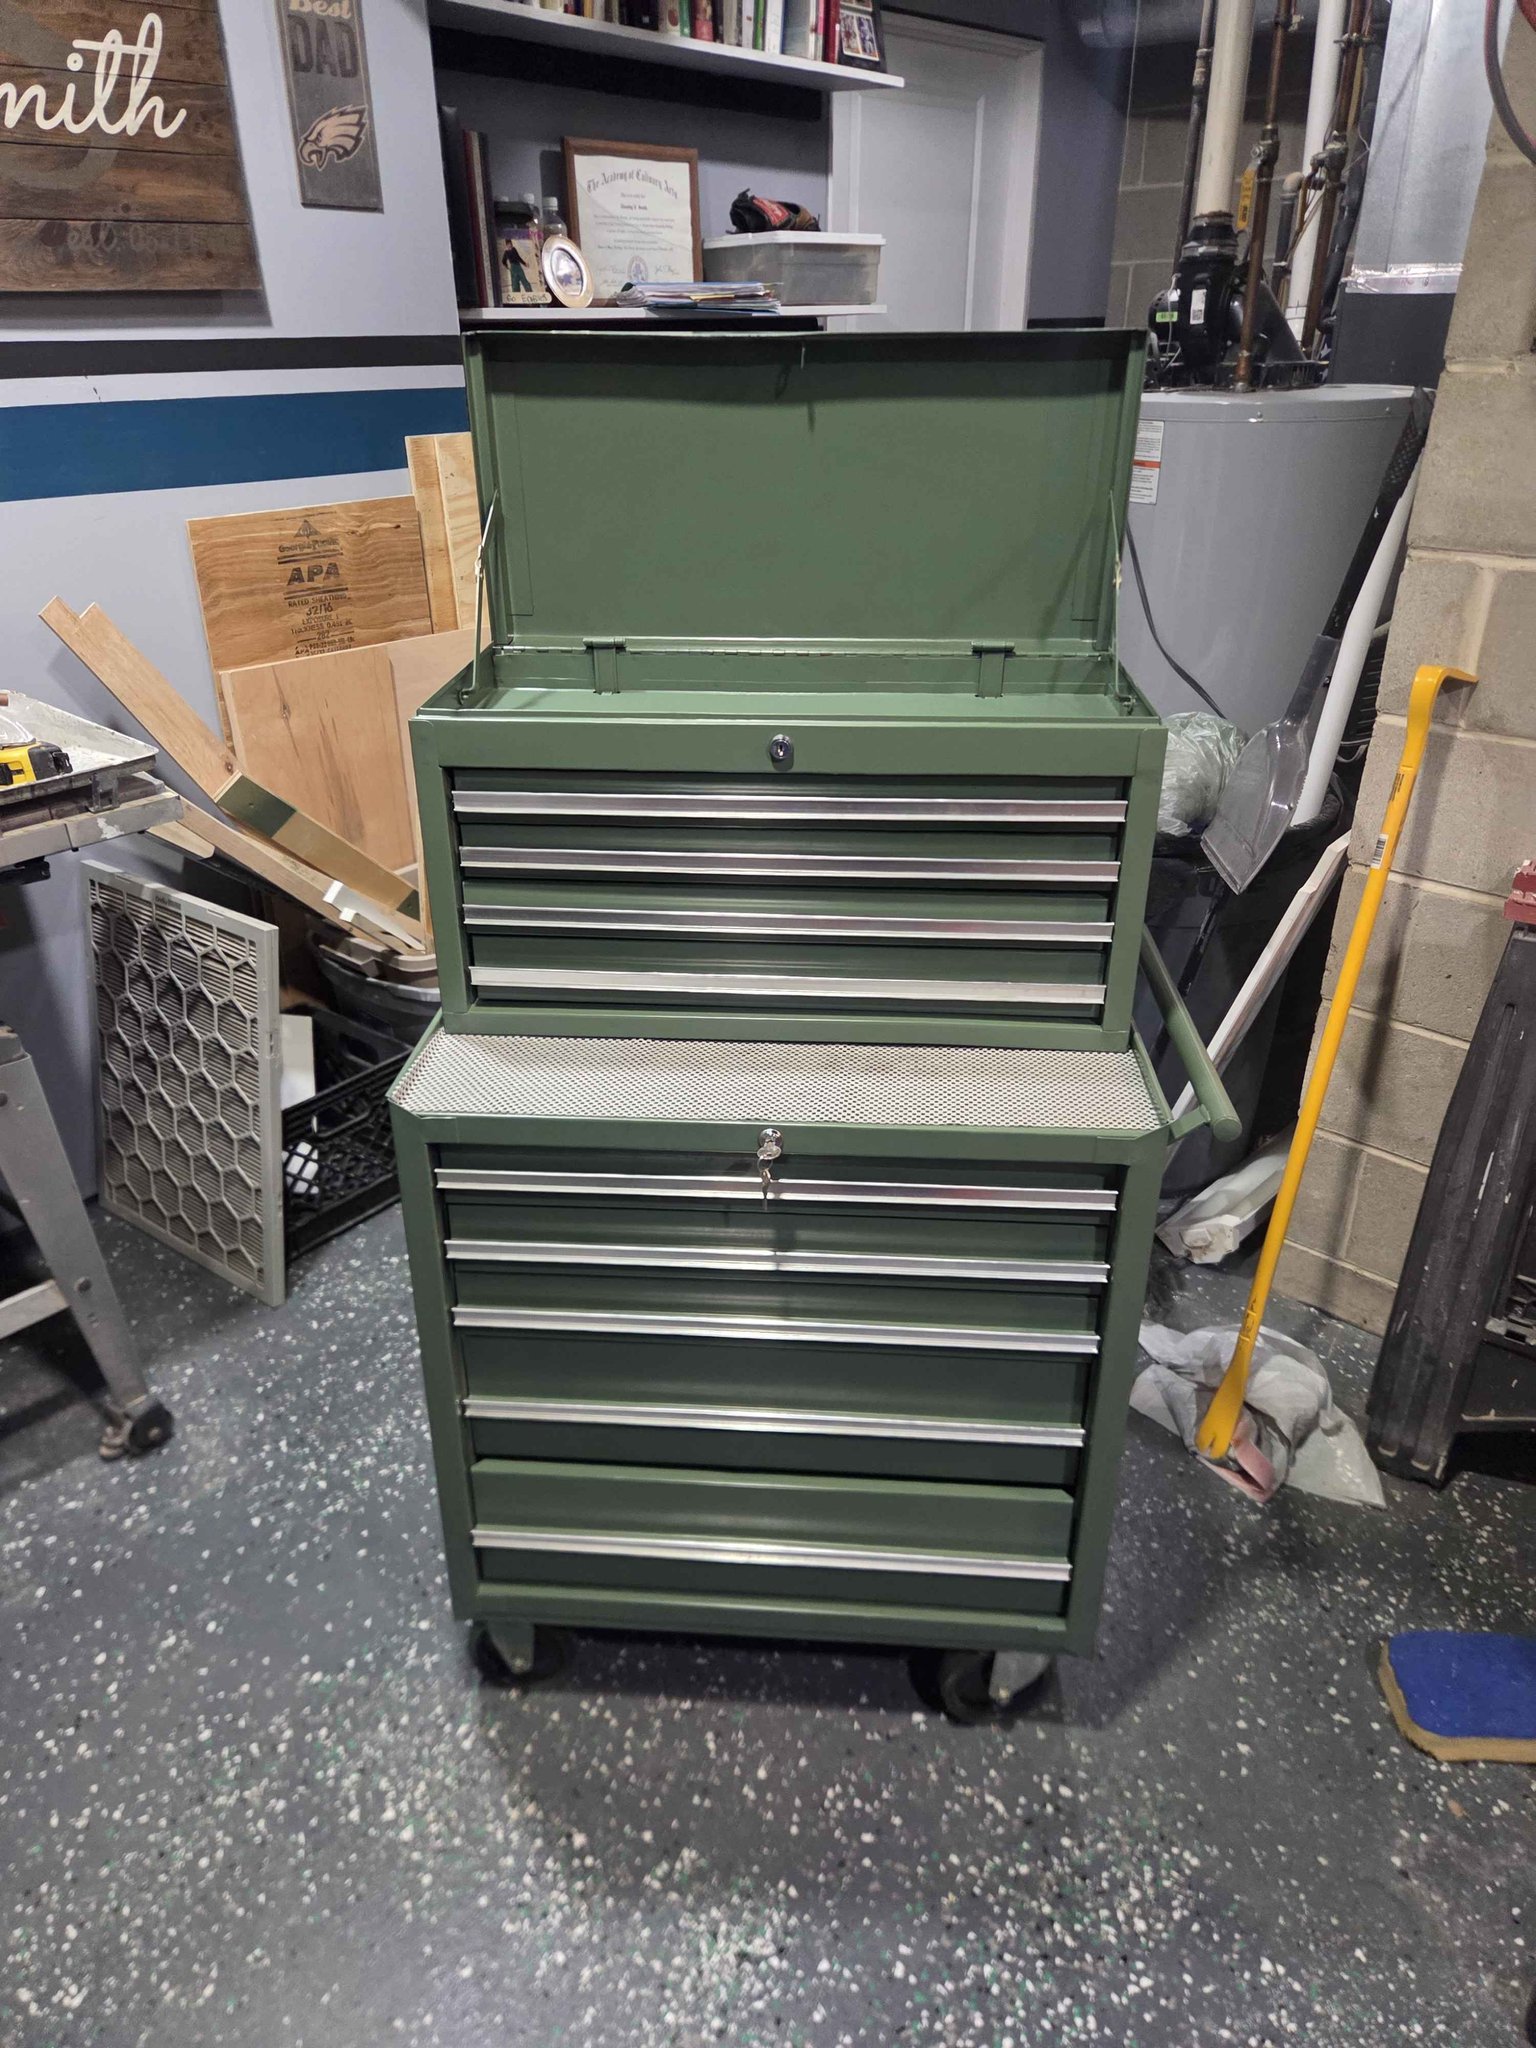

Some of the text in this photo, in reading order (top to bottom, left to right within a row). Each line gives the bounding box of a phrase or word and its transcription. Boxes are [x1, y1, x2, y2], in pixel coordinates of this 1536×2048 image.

[288, 14, 358, 79] DAD
[288, 562, 340, 585] APA
[306, 603, 334, 616] 32/16
